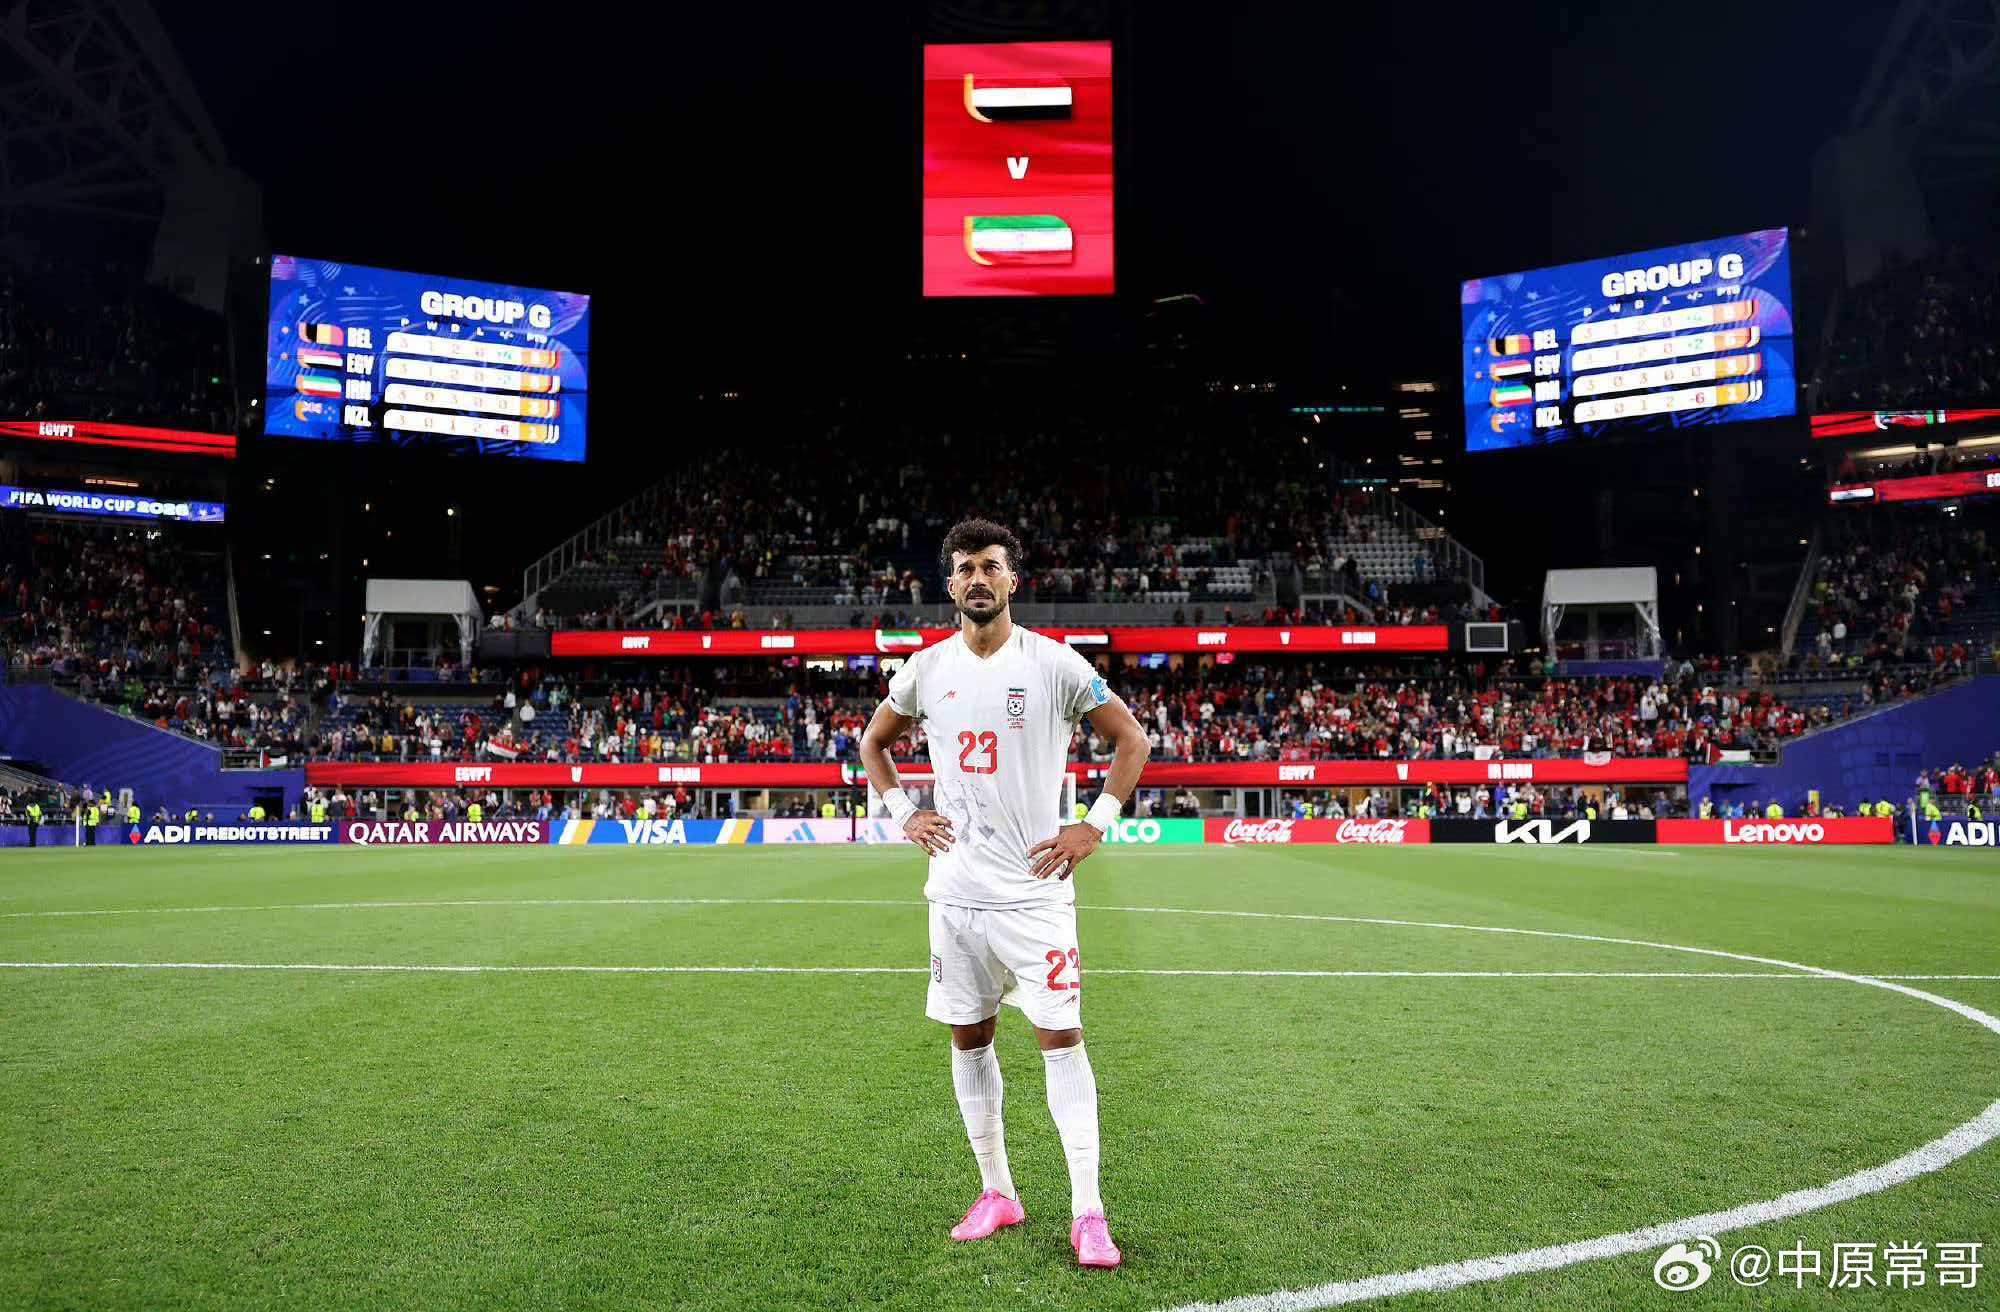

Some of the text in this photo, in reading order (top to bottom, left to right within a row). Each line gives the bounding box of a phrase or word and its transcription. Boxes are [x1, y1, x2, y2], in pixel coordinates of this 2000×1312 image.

[1007, 156, 1029, 180] V
[1601, 254, 1744, 297] GROUP G
[421, 291, 551, 328] GROUP G
[38, 421, 75, 438] EGYPT
[9, 491, 45, 506] FIFA
[46, 493, 103, 511] WORLD
[103, 498, 136, 513] CUP
[957, 731, 998, 775] 23
[143, 825, 332, 844] ADI PREDICTSTREET
[348, 821, 541, 847] QATAR AIRWAYS
[618, 819, 688, 845] VISA
[1723, 820, 1825, 843] Lenovo
[1946, 821, 1995, 846] ADI
